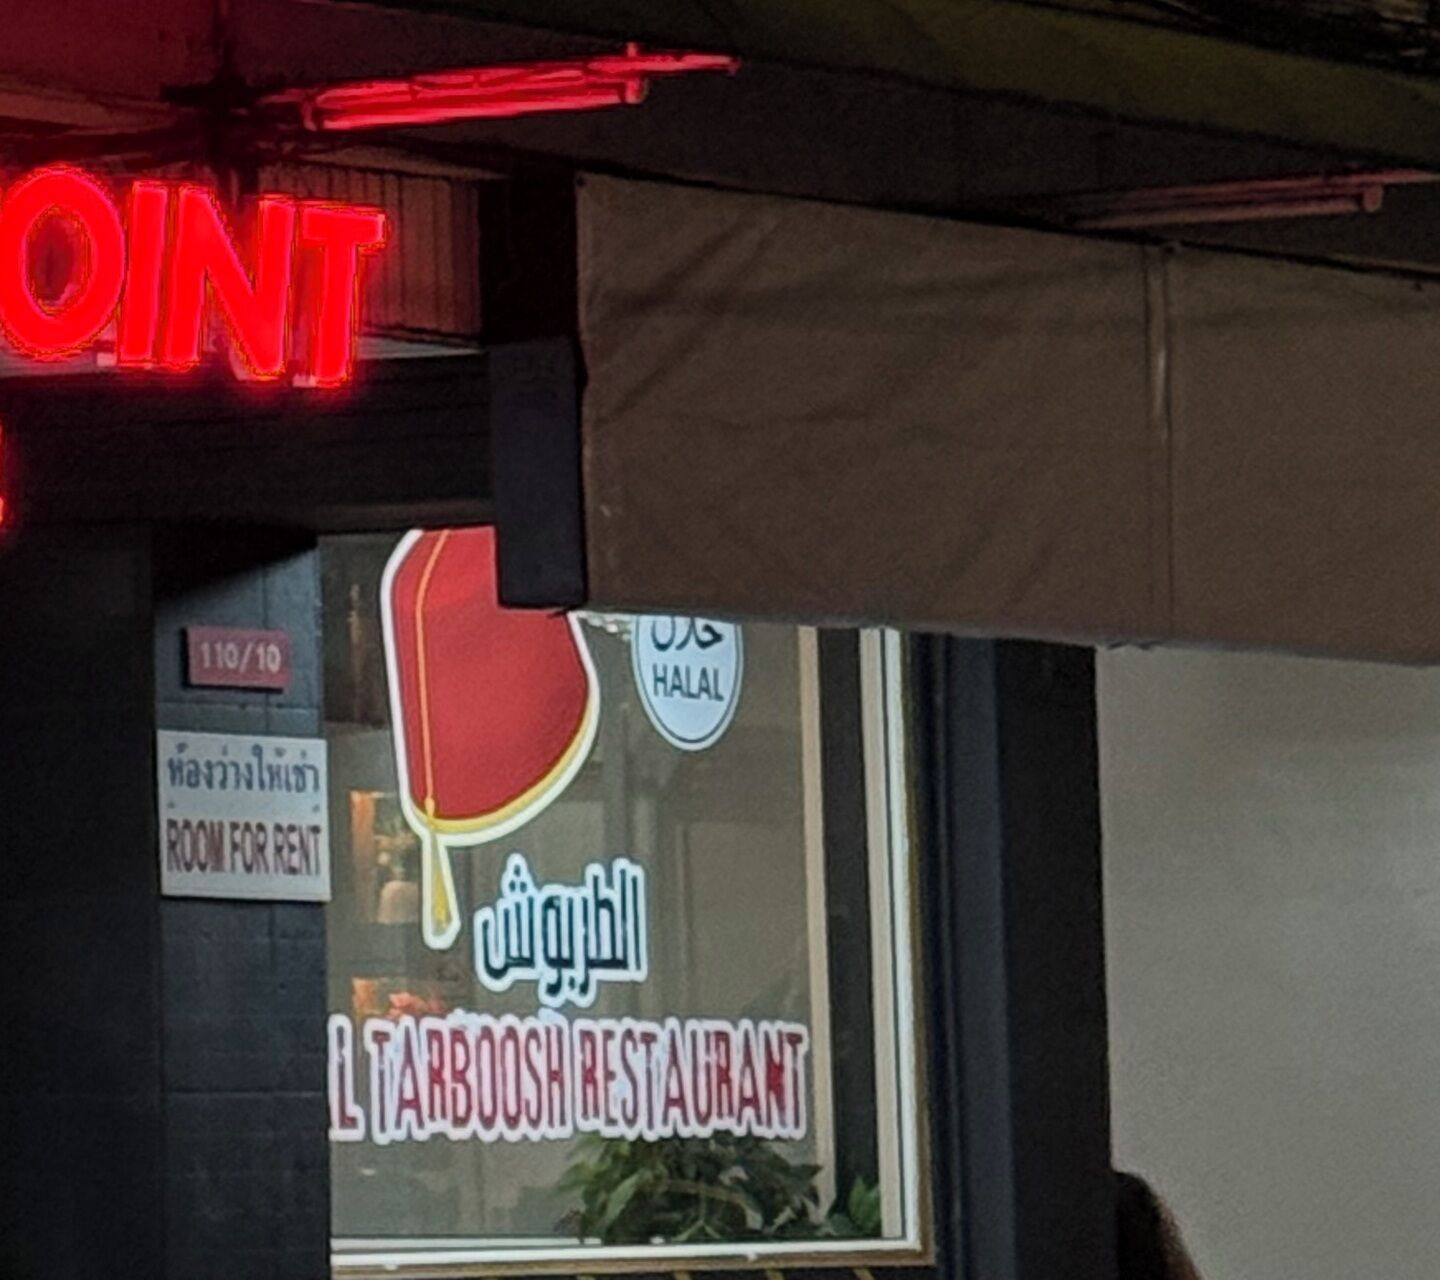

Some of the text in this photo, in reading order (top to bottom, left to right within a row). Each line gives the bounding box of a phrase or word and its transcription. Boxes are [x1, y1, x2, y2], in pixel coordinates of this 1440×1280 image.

[199, 640, 283, 675] 110/10
[651, 662, 725, 703] HALAL
[167, 741, 322, 795] ห้องว่างให้เช่า
[166, 817, 322, 877] ROOM FOR RENT
[481, 863, 643, 997] الطربوش
[370, 1023, 568, 1132] TARBOOSH
[579, 1025, 806, 1133] RESTAURANT
